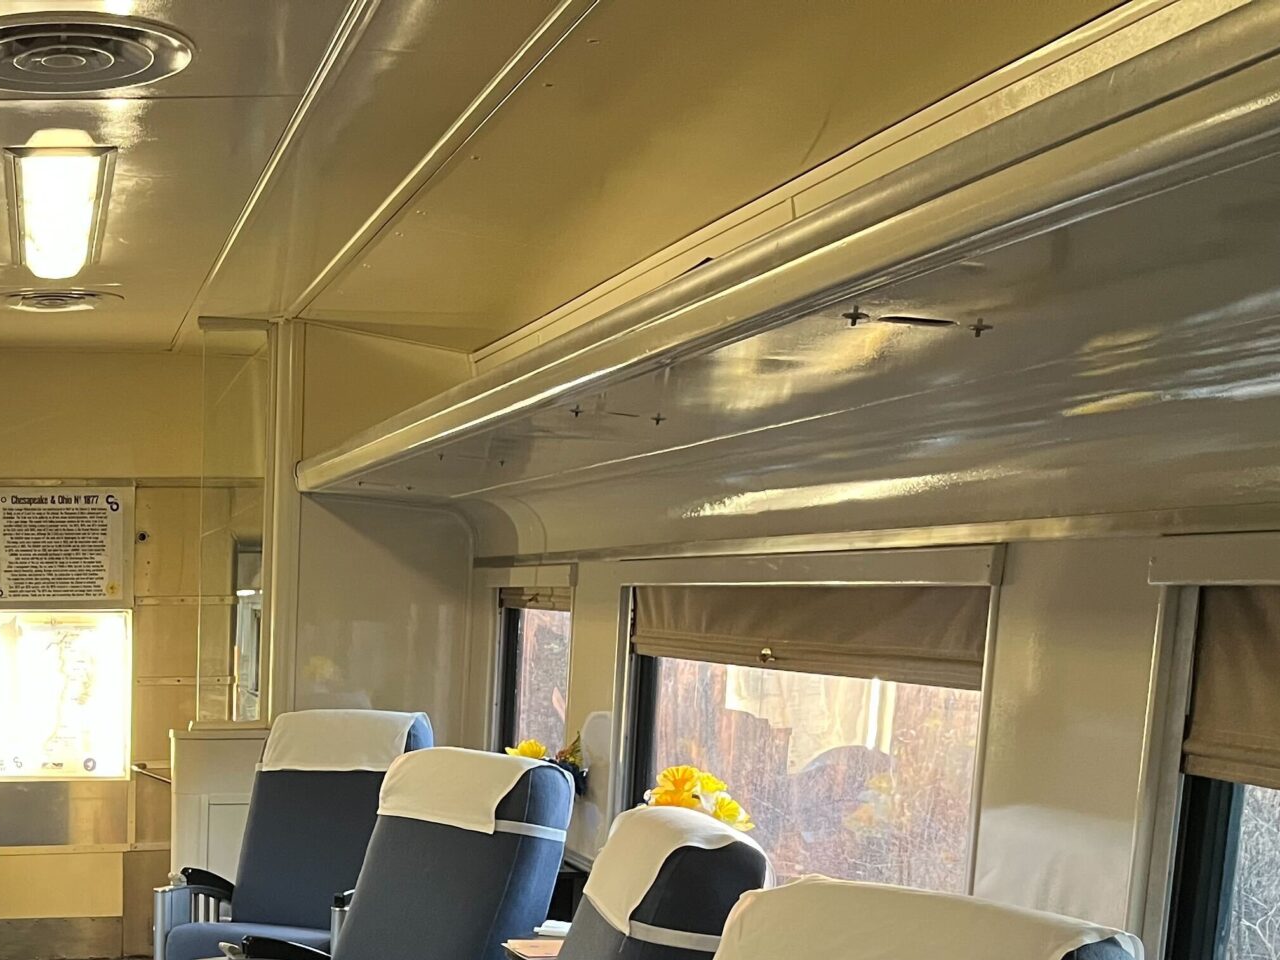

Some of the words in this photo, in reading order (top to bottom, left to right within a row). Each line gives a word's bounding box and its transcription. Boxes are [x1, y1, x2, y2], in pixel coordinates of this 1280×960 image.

[11, 495, 48, 506] Chesapeake
[50, 495, 56, 504] &
[58, 495, 72, 504] Ohio
[83, 495, 99, 504] 1877
